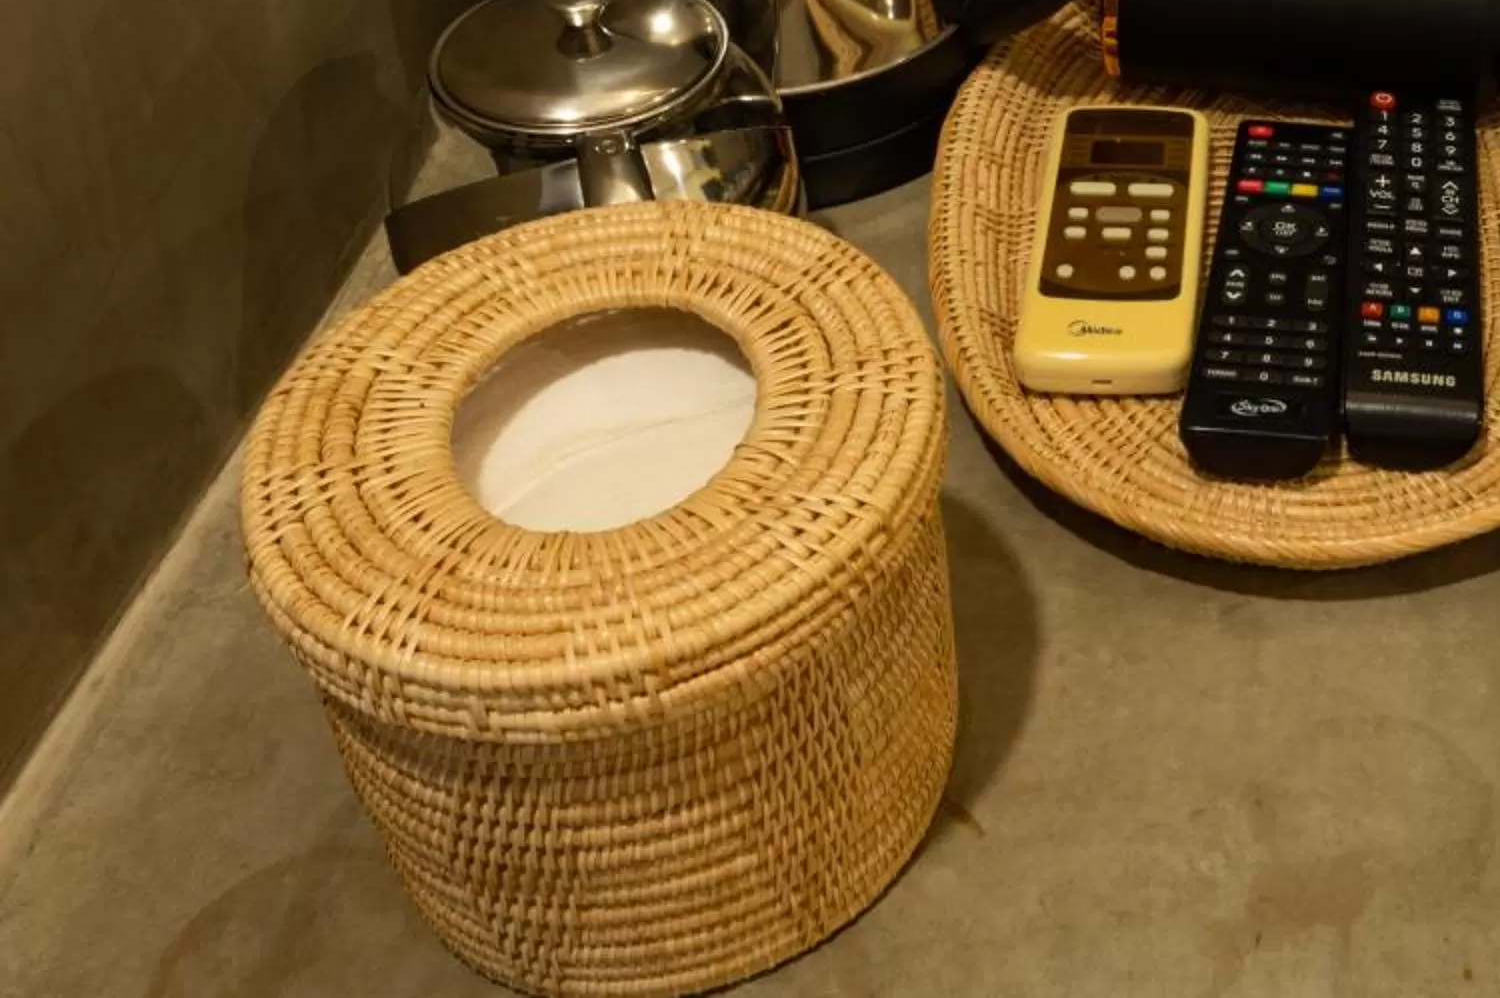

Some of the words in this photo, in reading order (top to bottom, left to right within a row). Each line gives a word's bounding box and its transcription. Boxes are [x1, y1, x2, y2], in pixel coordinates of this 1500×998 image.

[1411, 112, 1423, 124] 2
[1444, 115, 1455, 127] 3
[1377, 124, 1388, 135] 4
[1411, 127, 1422, 138] 5
[1444, 131, 1456, 141] 6
[1377, 139, 1388, 149] 7
[1411, 142, 1423, 153] 8
[1444, 145, 1456, 156] 9
[1411, 157, 1422, 167] 0
[1368, 189, 1397, 200] VOL
[1075, 321, 1123, 336] Midea
[1371, 369, 1456, 387] SAMSUNG
